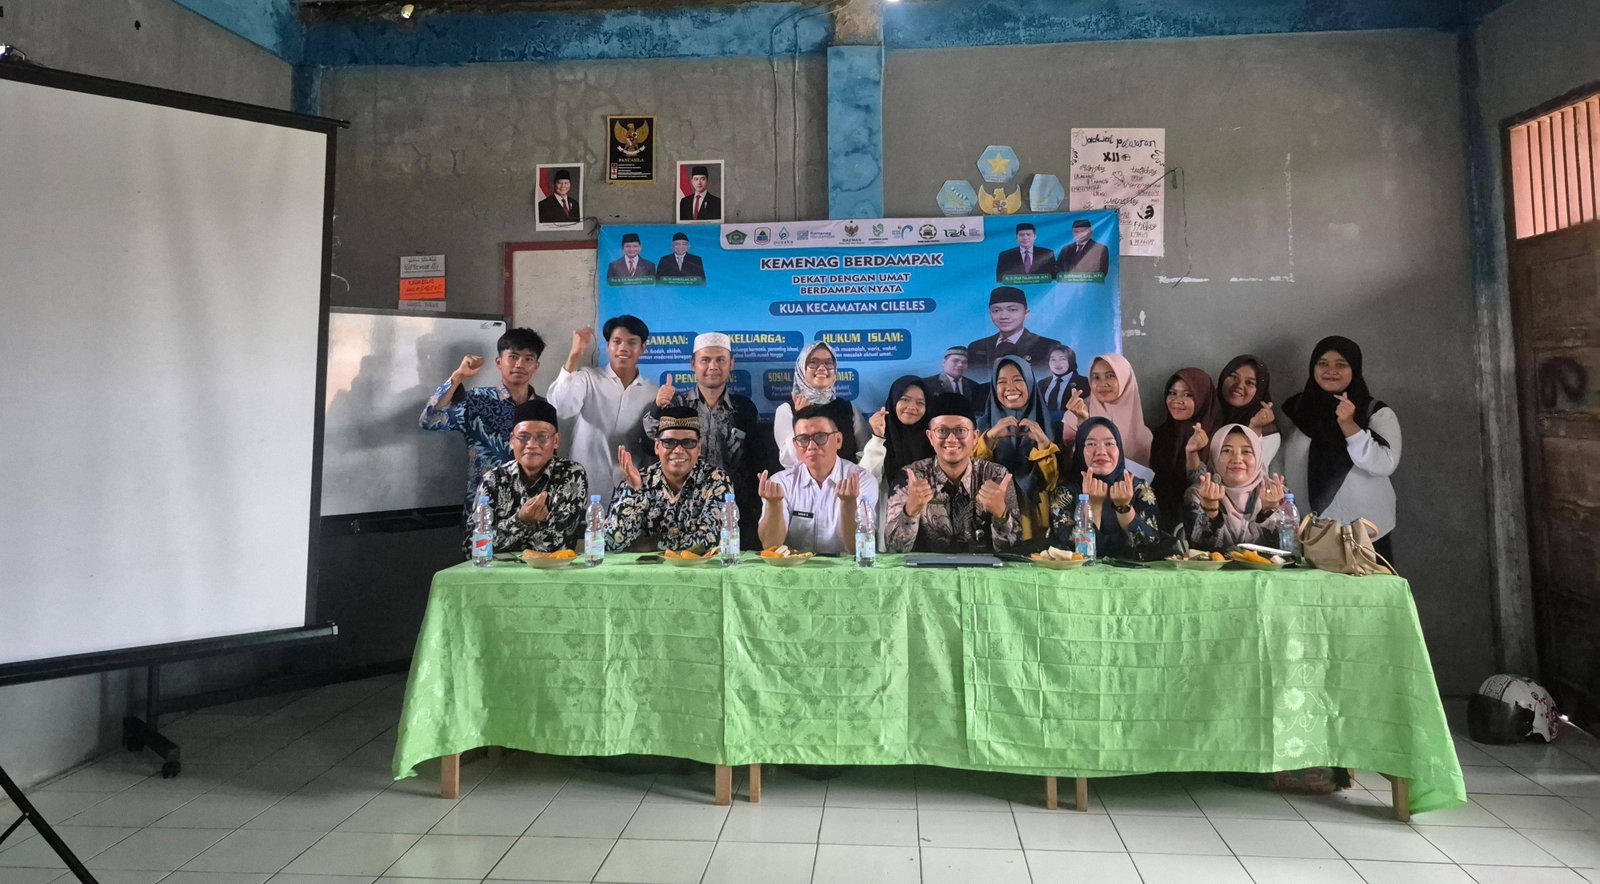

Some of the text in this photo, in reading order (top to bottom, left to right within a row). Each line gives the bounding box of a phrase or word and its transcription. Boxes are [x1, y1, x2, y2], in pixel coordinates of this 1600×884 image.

[1102, 151, 1120, 162] XII
[761, 253, 943, 269] KEMENAG BERDAMPAK
[792, 273, 911, 284] DEKAT DENGAN UMAT
[800, 284, 903, 295] BERDAMPAK NYATA
[779, 300, 925, 313] KUA KECAMATAN CILELES
[729, 333, 786, 343] KELUARGA:
[822, 332, 904, 343] HUKUM ISLAM:
